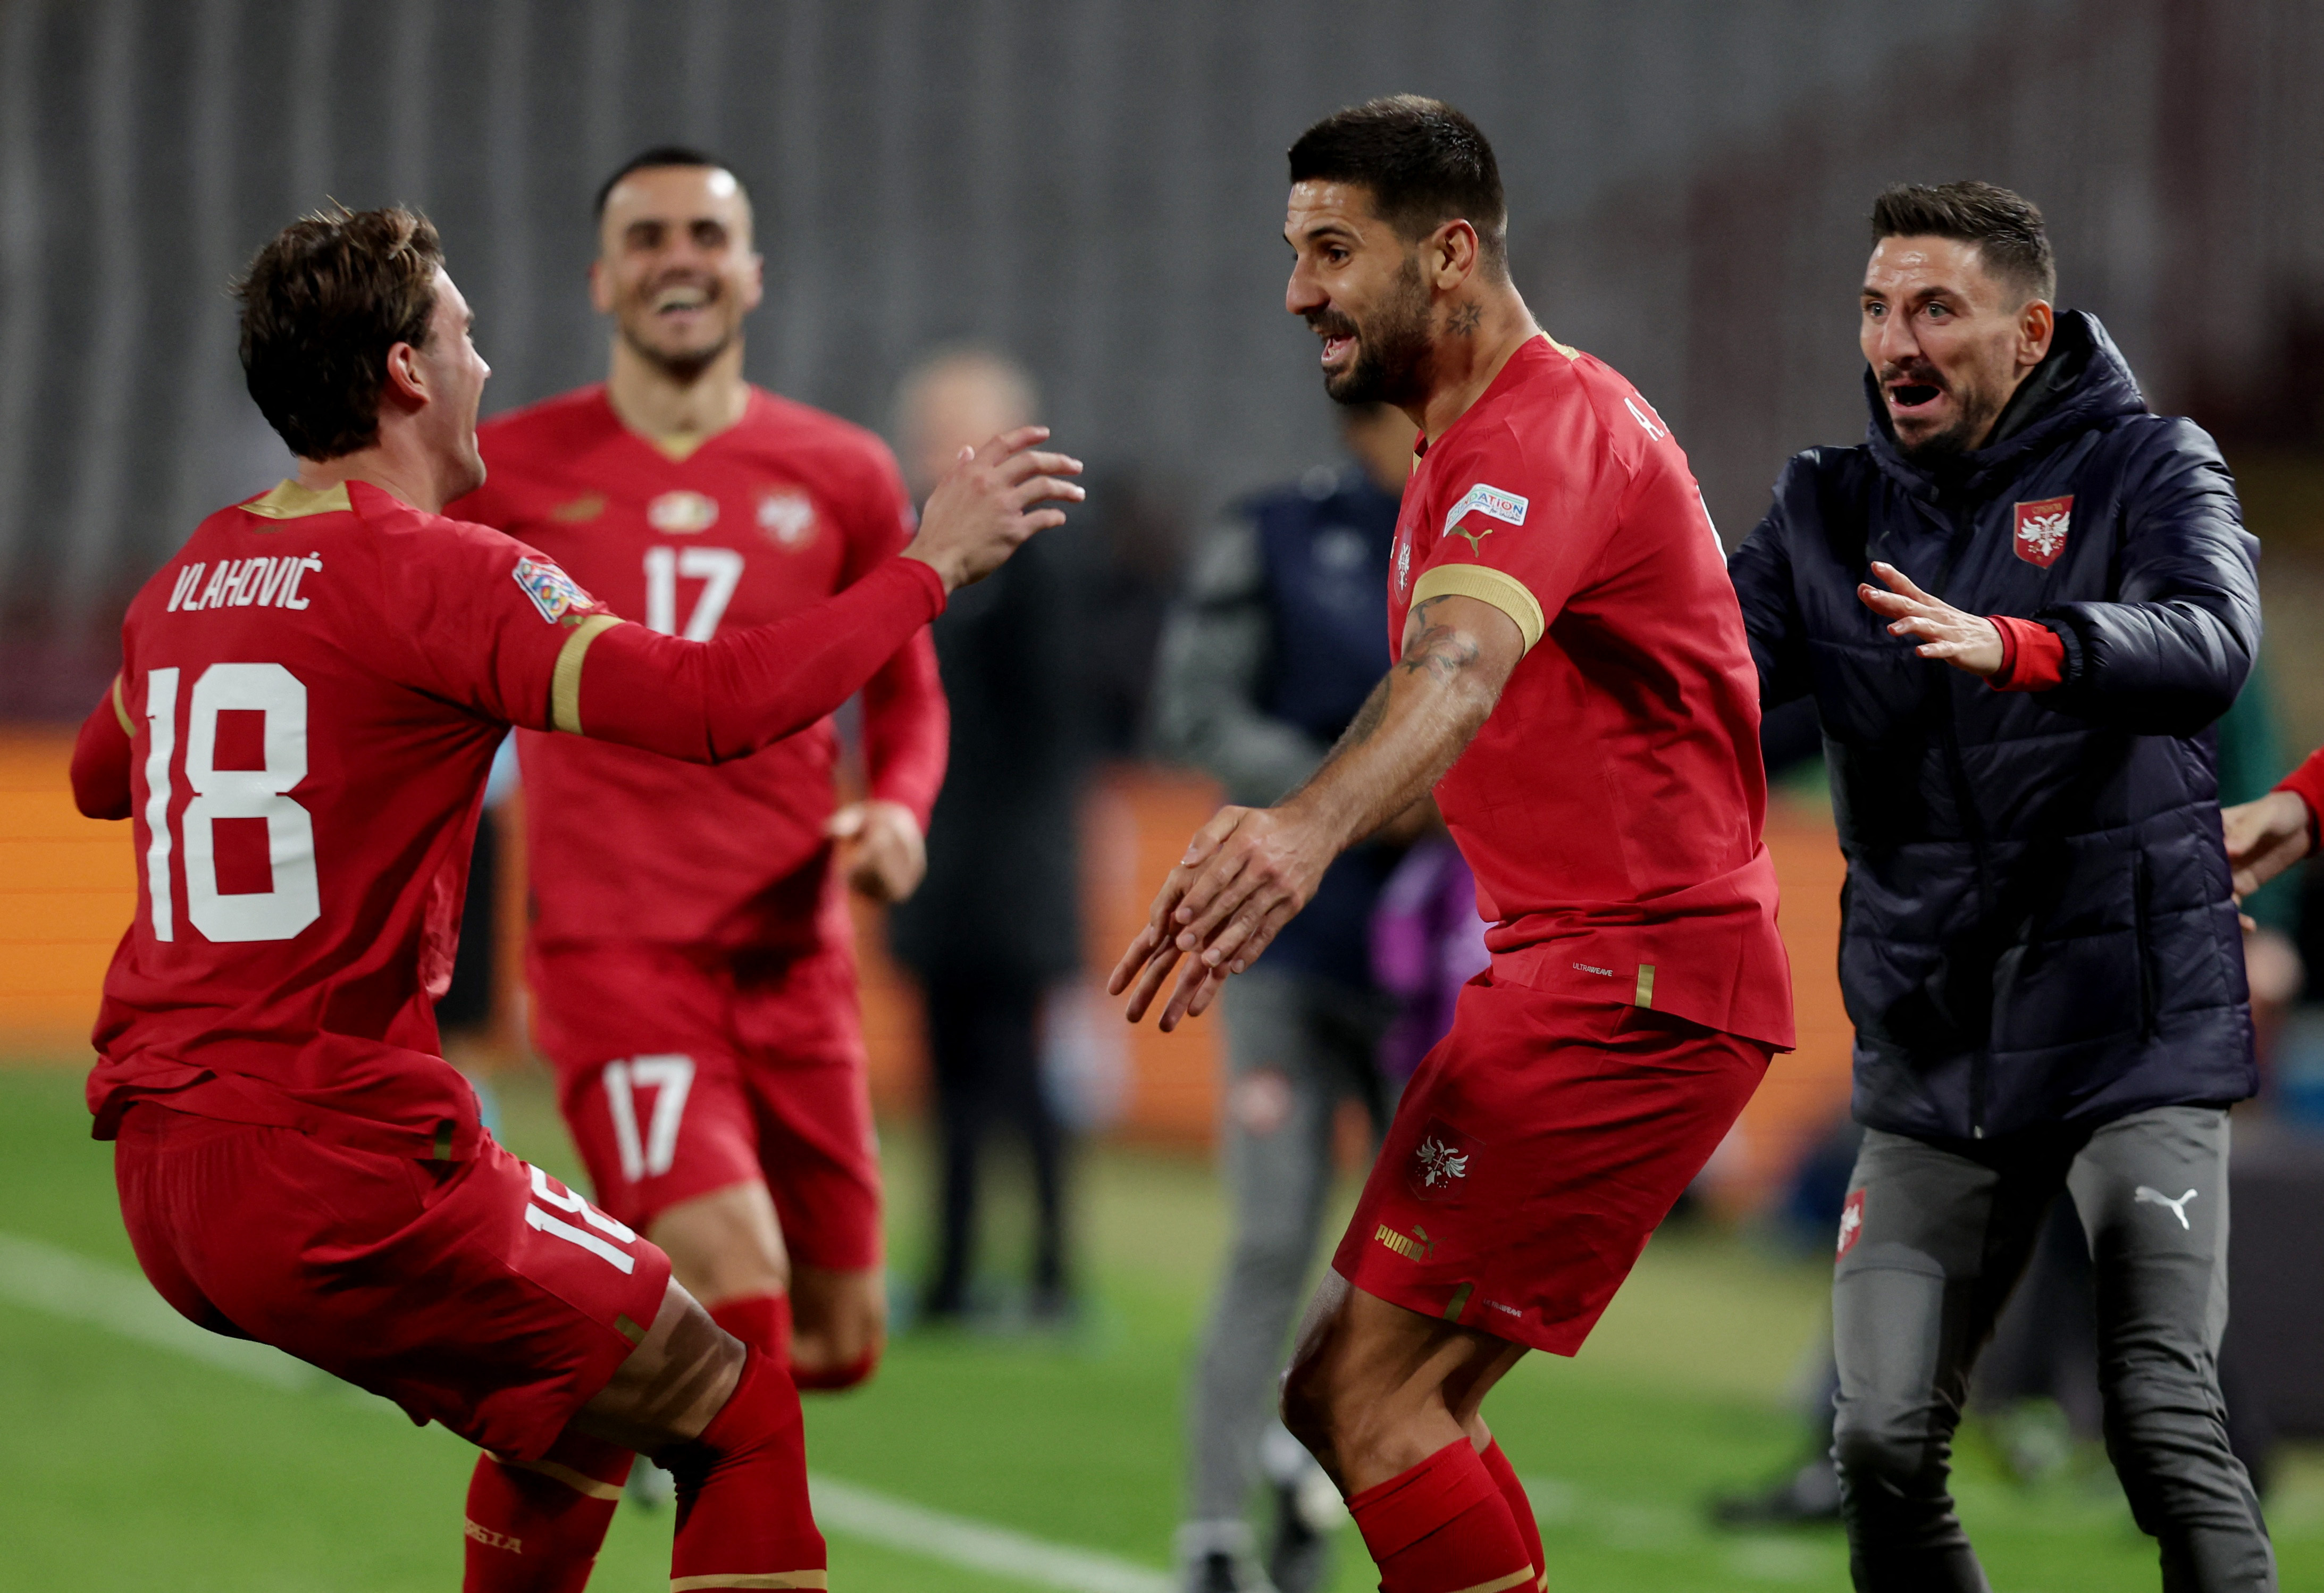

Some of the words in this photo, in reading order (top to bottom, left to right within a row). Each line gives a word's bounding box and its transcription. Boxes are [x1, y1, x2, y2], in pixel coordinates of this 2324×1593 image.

[166, 551, 323, 613] VLAHOVIĆ
[643, 545, 744, 643] 17
[145, 663, 321, 943] 18
[1573, 962, 1613, 977] ULTRAWEAVE
[602, 1052, 697, 1184] 17
[1374, 1223, 1425, 1263] PUMA
